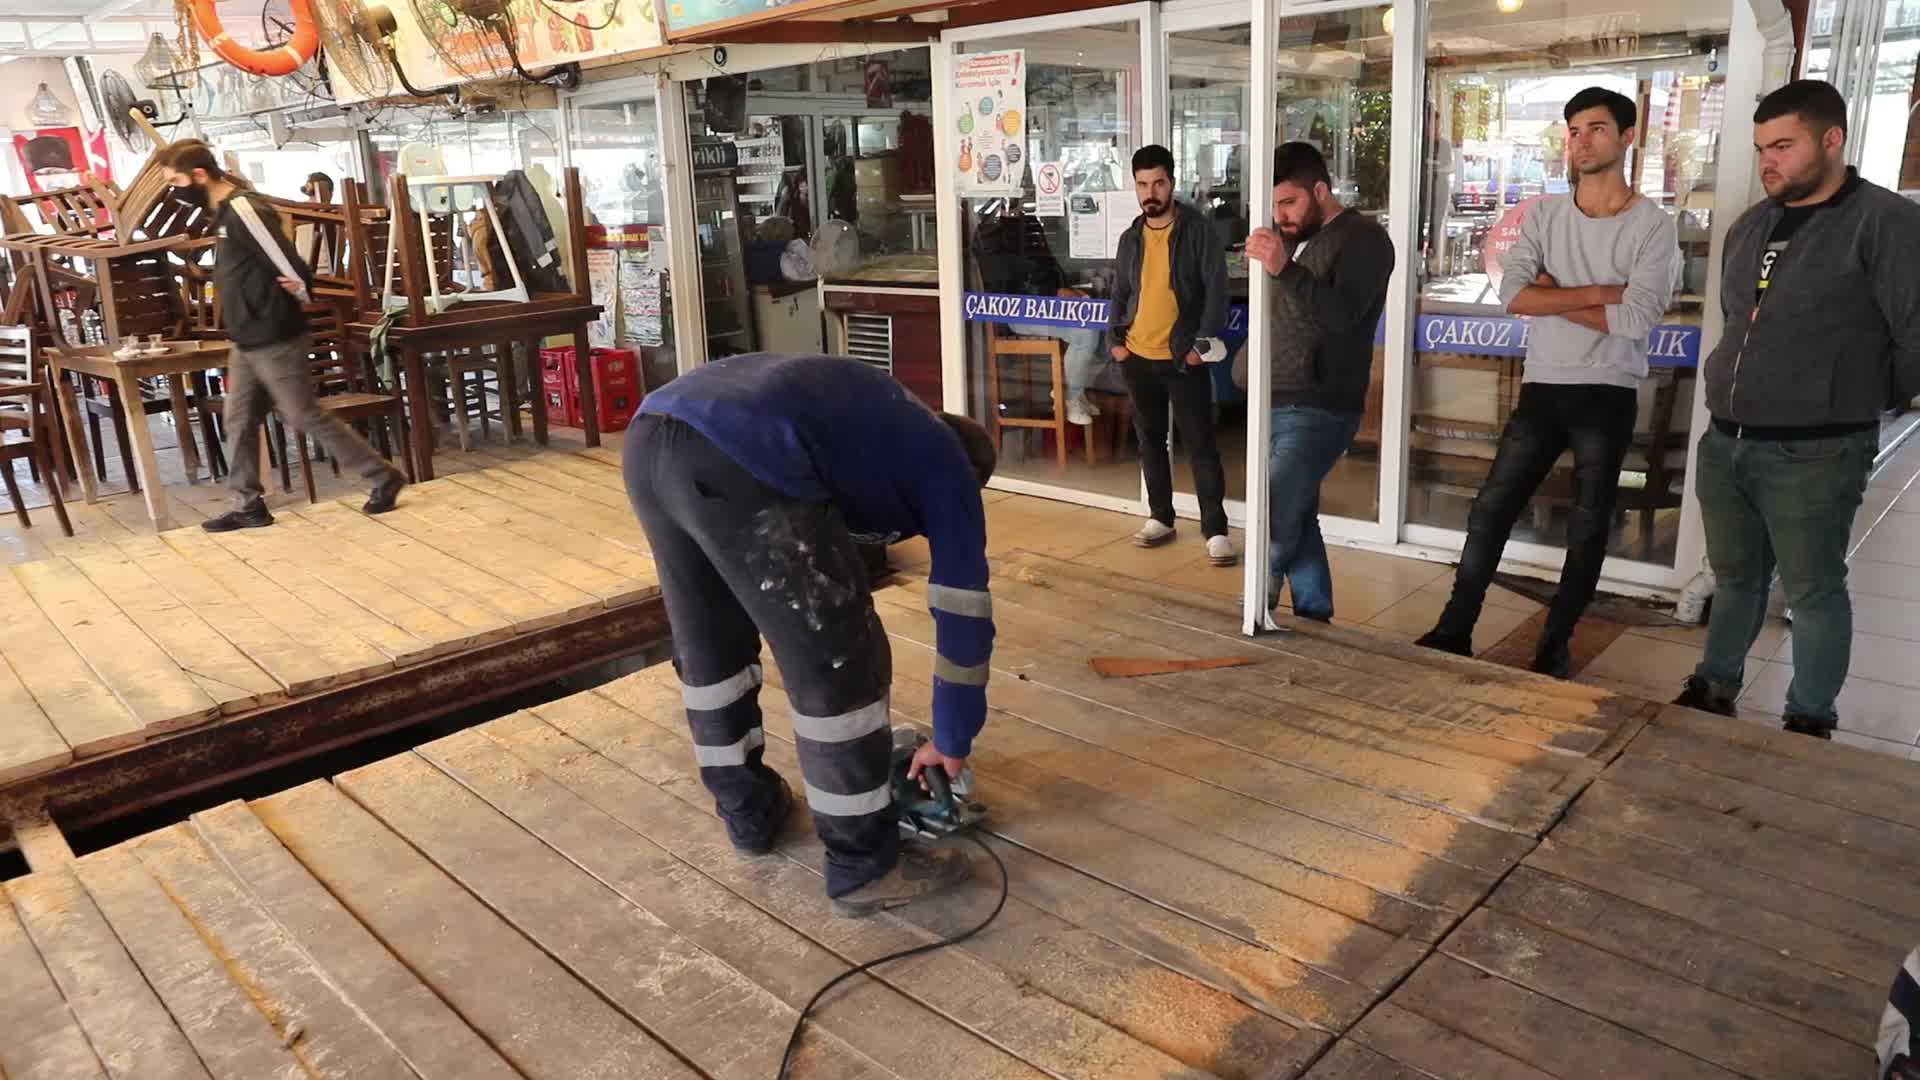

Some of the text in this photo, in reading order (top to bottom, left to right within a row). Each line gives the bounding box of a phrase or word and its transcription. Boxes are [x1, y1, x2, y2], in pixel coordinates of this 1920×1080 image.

[965, 295, 1109, 327] ÇAKOZ BALIKÇIL
[1425, 319, 1512, 349] ÇAKOZ
